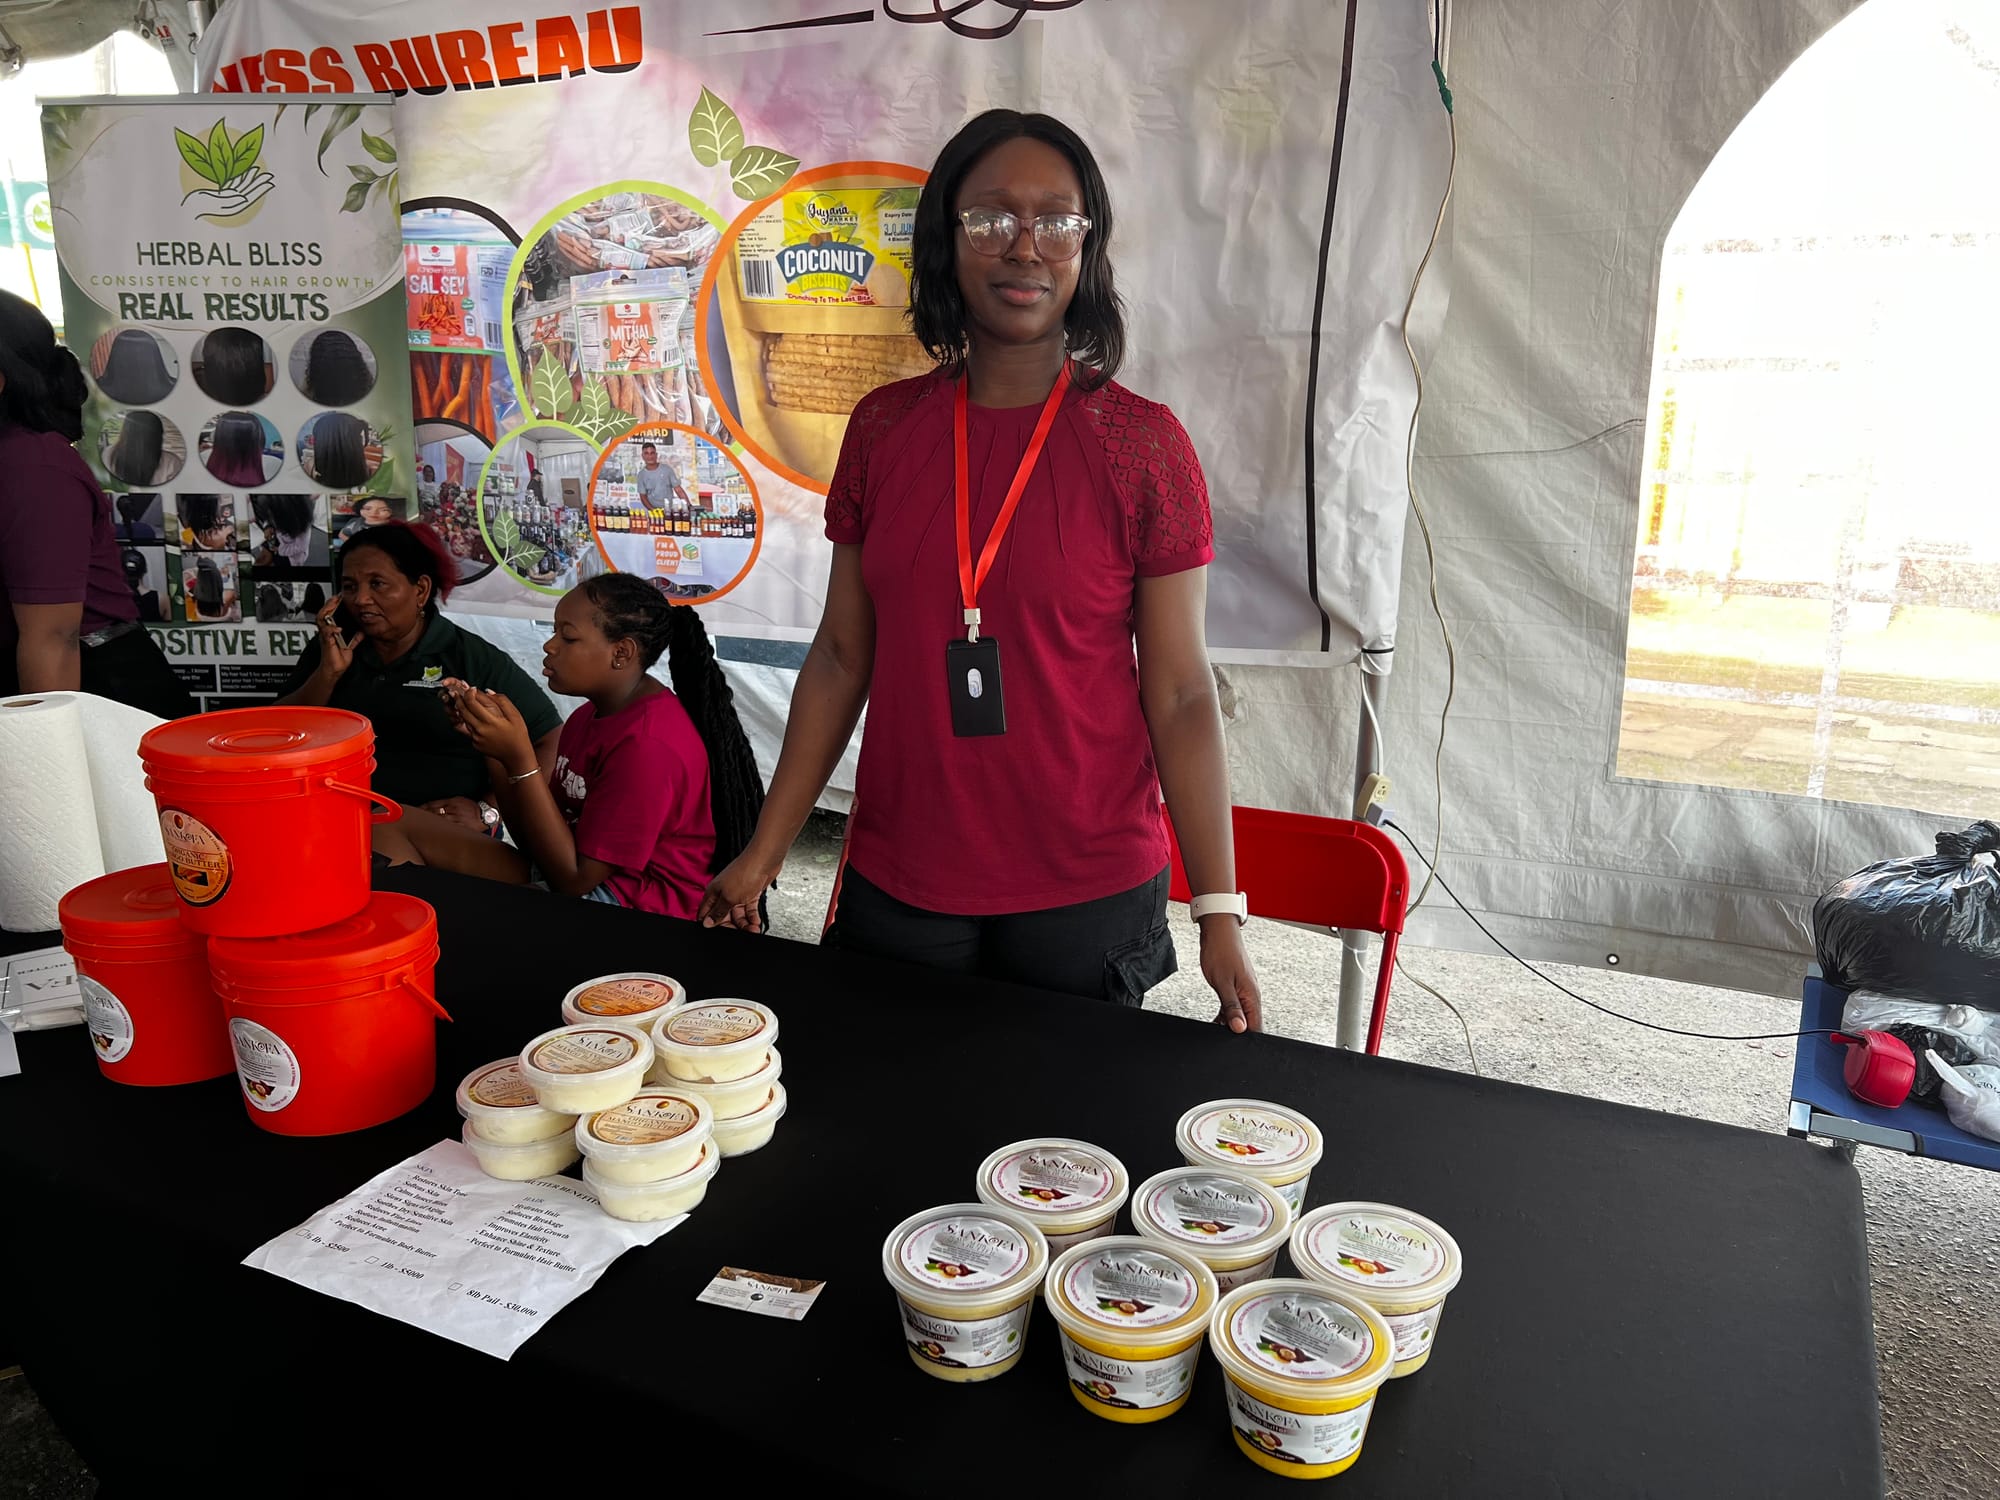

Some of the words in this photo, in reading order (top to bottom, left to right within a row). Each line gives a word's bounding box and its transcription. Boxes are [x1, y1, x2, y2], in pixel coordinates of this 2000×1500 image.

[354, 6, 642, 98] BUREAU
[807, 203, 850, 225] Guyana
[137, 242, 242, 266] HERBAL
[249, 242, 323, 266] BLISS
[784, 249, 866, 278] COCONUT
[90, 275, 211, 287] CONSISTENCY
[221, 276, 242, 287] TO
[251, 276, 288, 287] HAIR
[297, 275, 375, 289] GROWTH
[409, 274, 440, 294] SAL
[440, 275, 466, 295] SEV
[801, 274, 848, 291] BISCUITS
[118, 292, 194, 321] REAL
[205, 292, 330, 322] RESULTS
[819, 296, 828, 304] To
[828, 296, 840, 304] The
[609, 325, 649, 341] MITHAI
[655, 550, 679, 558] PROUD
[656, 559, 680, 567] CLIENT
[186, 857, 221, 869] BUTTER
[626, 1105, 684, 1121] SANKOFA
[1228, 1112, 1294, 1137] SANKOFA
[1028, 1155, 1098, 1176] SANKOFA
[403, 1180, 425, 1193] Softens
[425, 1188, 440, 1198] Skin
[412, 1174, 438, 1188] Restores
[560, 1185, 601, 1206] BENEFITS
[1178, 1185, 1255, 1204] SANKOFA
[514, 1203, 544, 1215] Hydrates
[543, 1208, 561, 1218] Hair
[487, 1221, 519, 1237] Improves
[519, 1231, 550, 1244] Elasticity
[497, 1215, 528, 1229] Promotes
[527, 1223, 544, 1232] Hair
[543, 1227, 570, 1240] Growth
[533, 1215, 564, 1229] Breakage
[334, 1219, 358, 1232] Perfect
[364, 1227, 398, 1245] Formulate
[397, 1240, 415, 1252] Body
[414, 1247, 438, 1258] Butter
[478, 1228, 508, 1243] Enhance
[507, 1237, 526, 1248] Shine
[535, 1245, 561, 1258] Texture
[947, 1223, 1015, 1252] SANKOFA
[1350, 1219, 1427, 1251] SANKOFA
[470, 1237, 495, 1251] Perfect
[501, 1246, 537, 1261] Formulate
[536, 1256, 555, 1267] Hair
[553, 1261, 576, 1273] Butter
[398, 1267, 425, 1280] $5000
[1099, 1257, 1179, 1281] SANKOFA
[466, 1289, 481, 1299] 8lb
[480, 1293, 499, 1306] Pail
[503, 1302, 539, 1317] $30,000
[905, 1306, 960, 1336] ANKOFA
[1282, 1300, 1357, 1341] SANKOFA
[1072, 1345, 1134, 1376] SANKOFA
[1237, 1391, 1302, 1429] SANKOFA
